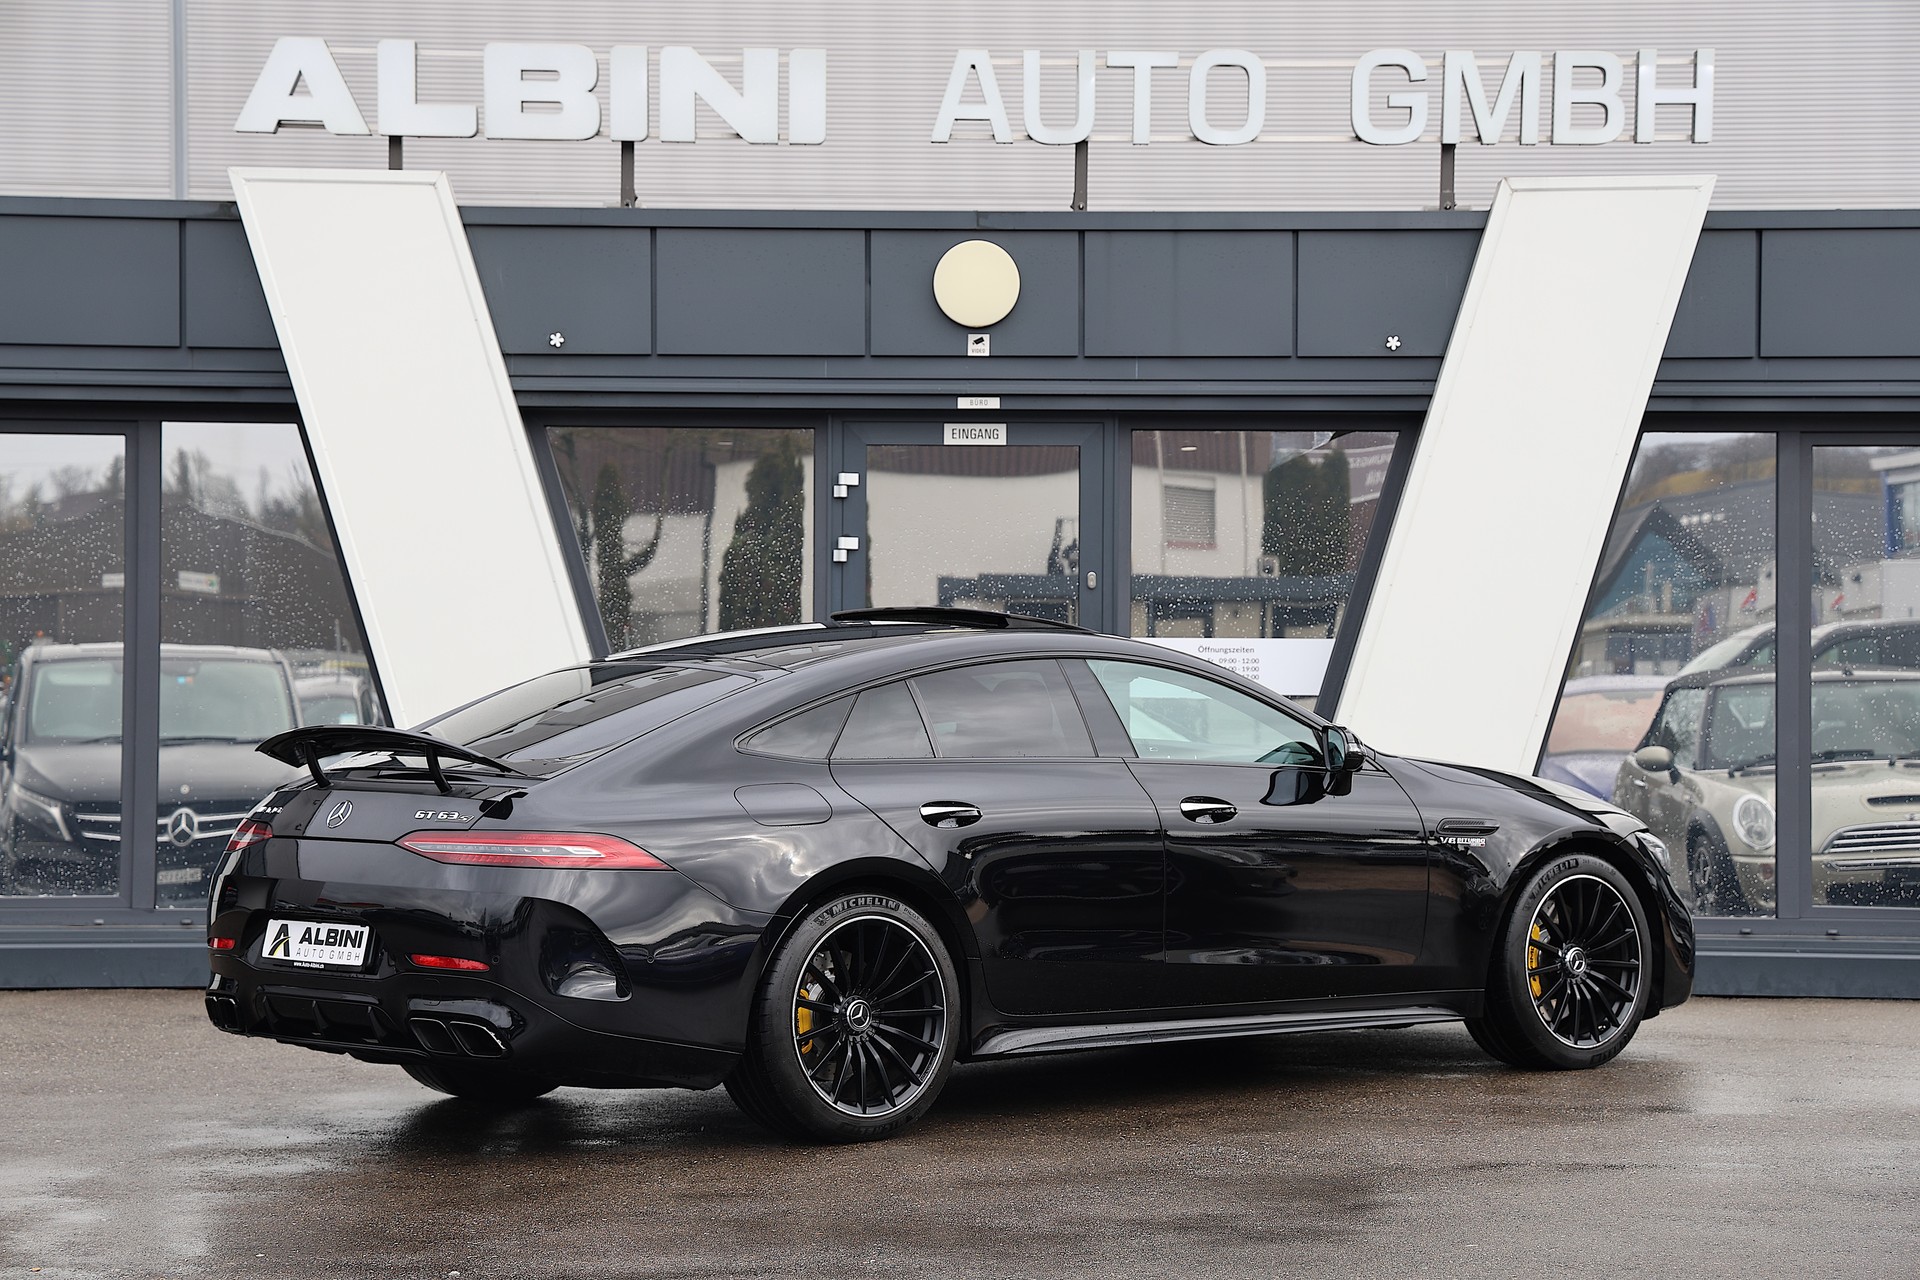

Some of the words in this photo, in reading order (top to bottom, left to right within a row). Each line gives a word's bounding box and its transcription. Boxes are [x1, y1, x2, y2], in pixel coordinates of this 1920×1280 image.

[234, 36, 827, 145] ALBINI
[930, 48, 1267, 145] AUTO
[1351, 48, 1716, 145] GMBH
[951, 428, 999, 439] EINGANG
[1198, 645, 1255, 654] Öffnungszeiten
[414, 810, 437, 820] GT
[1532, 859, 1578, 898] MICHELIN
[832, 897, 897, 915] MICHELIN
[299, 927, 364, 948] ALBINI
[296, 948, 324, 959] AUTO
[329, 950, 361, 961] GMBH
